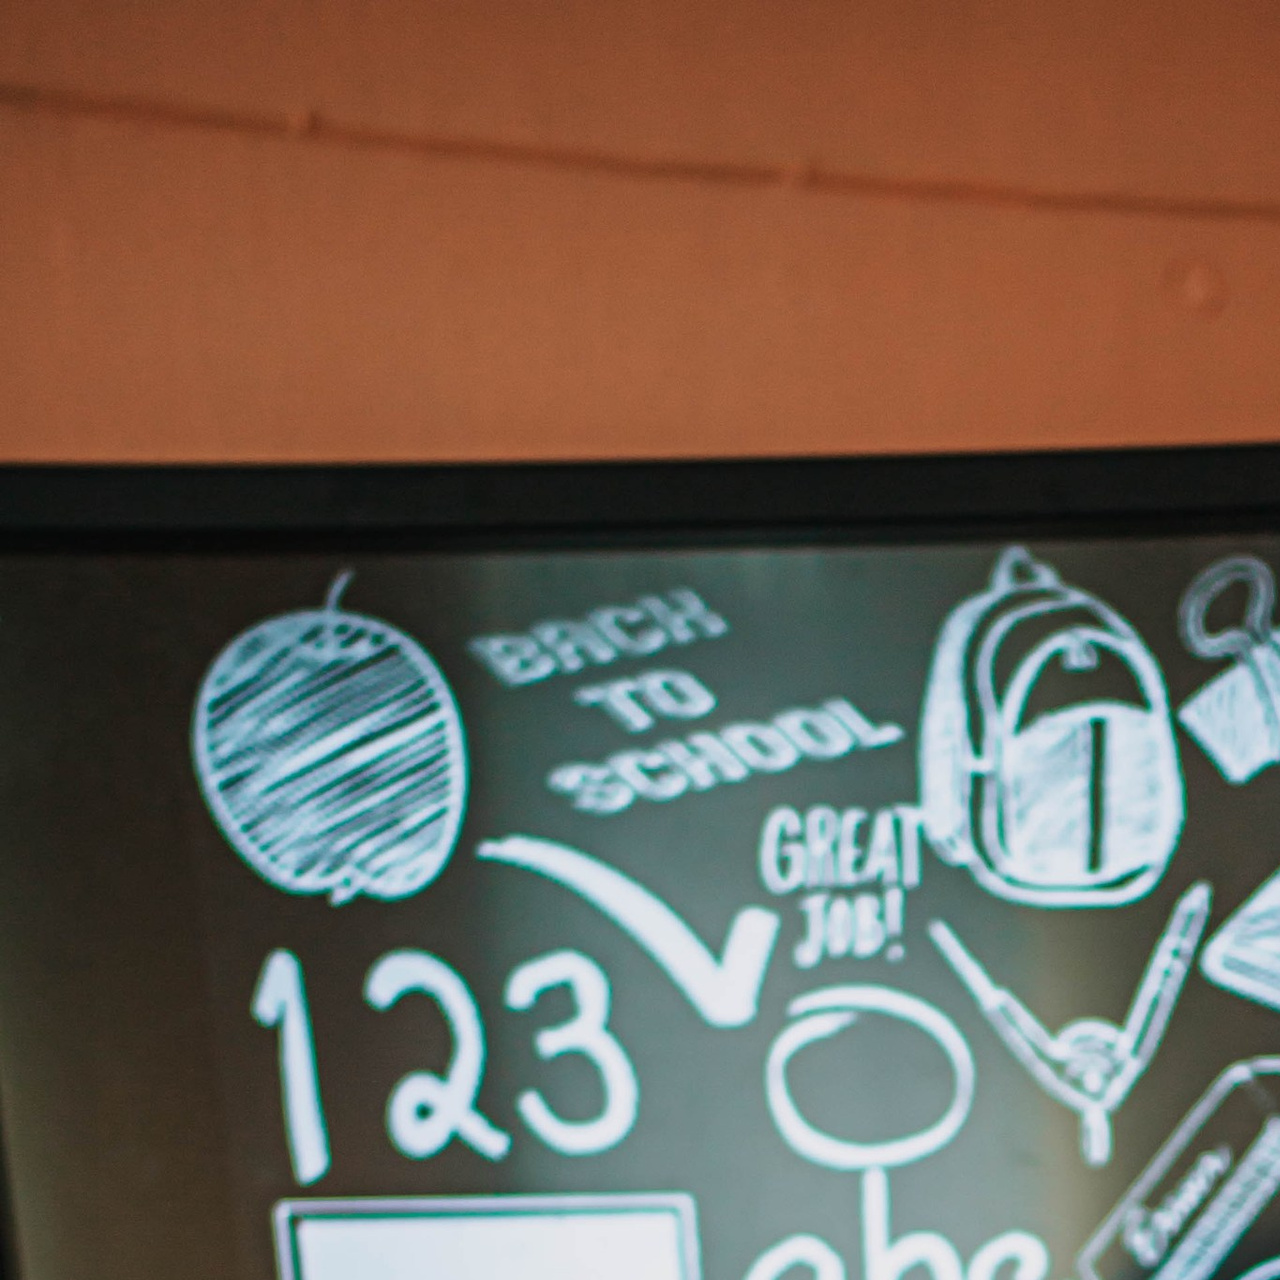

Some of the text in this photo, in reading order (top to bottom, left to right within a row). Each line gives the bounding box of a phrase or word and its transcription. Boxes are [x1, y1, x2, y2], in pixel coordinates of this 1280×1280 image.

[573, 668, 718, 733] TO
[546, 697, 906, 815] SCHOOL
[758, 804, 925, 895] GREAT
[794, 886, 906, 968] JOB!
